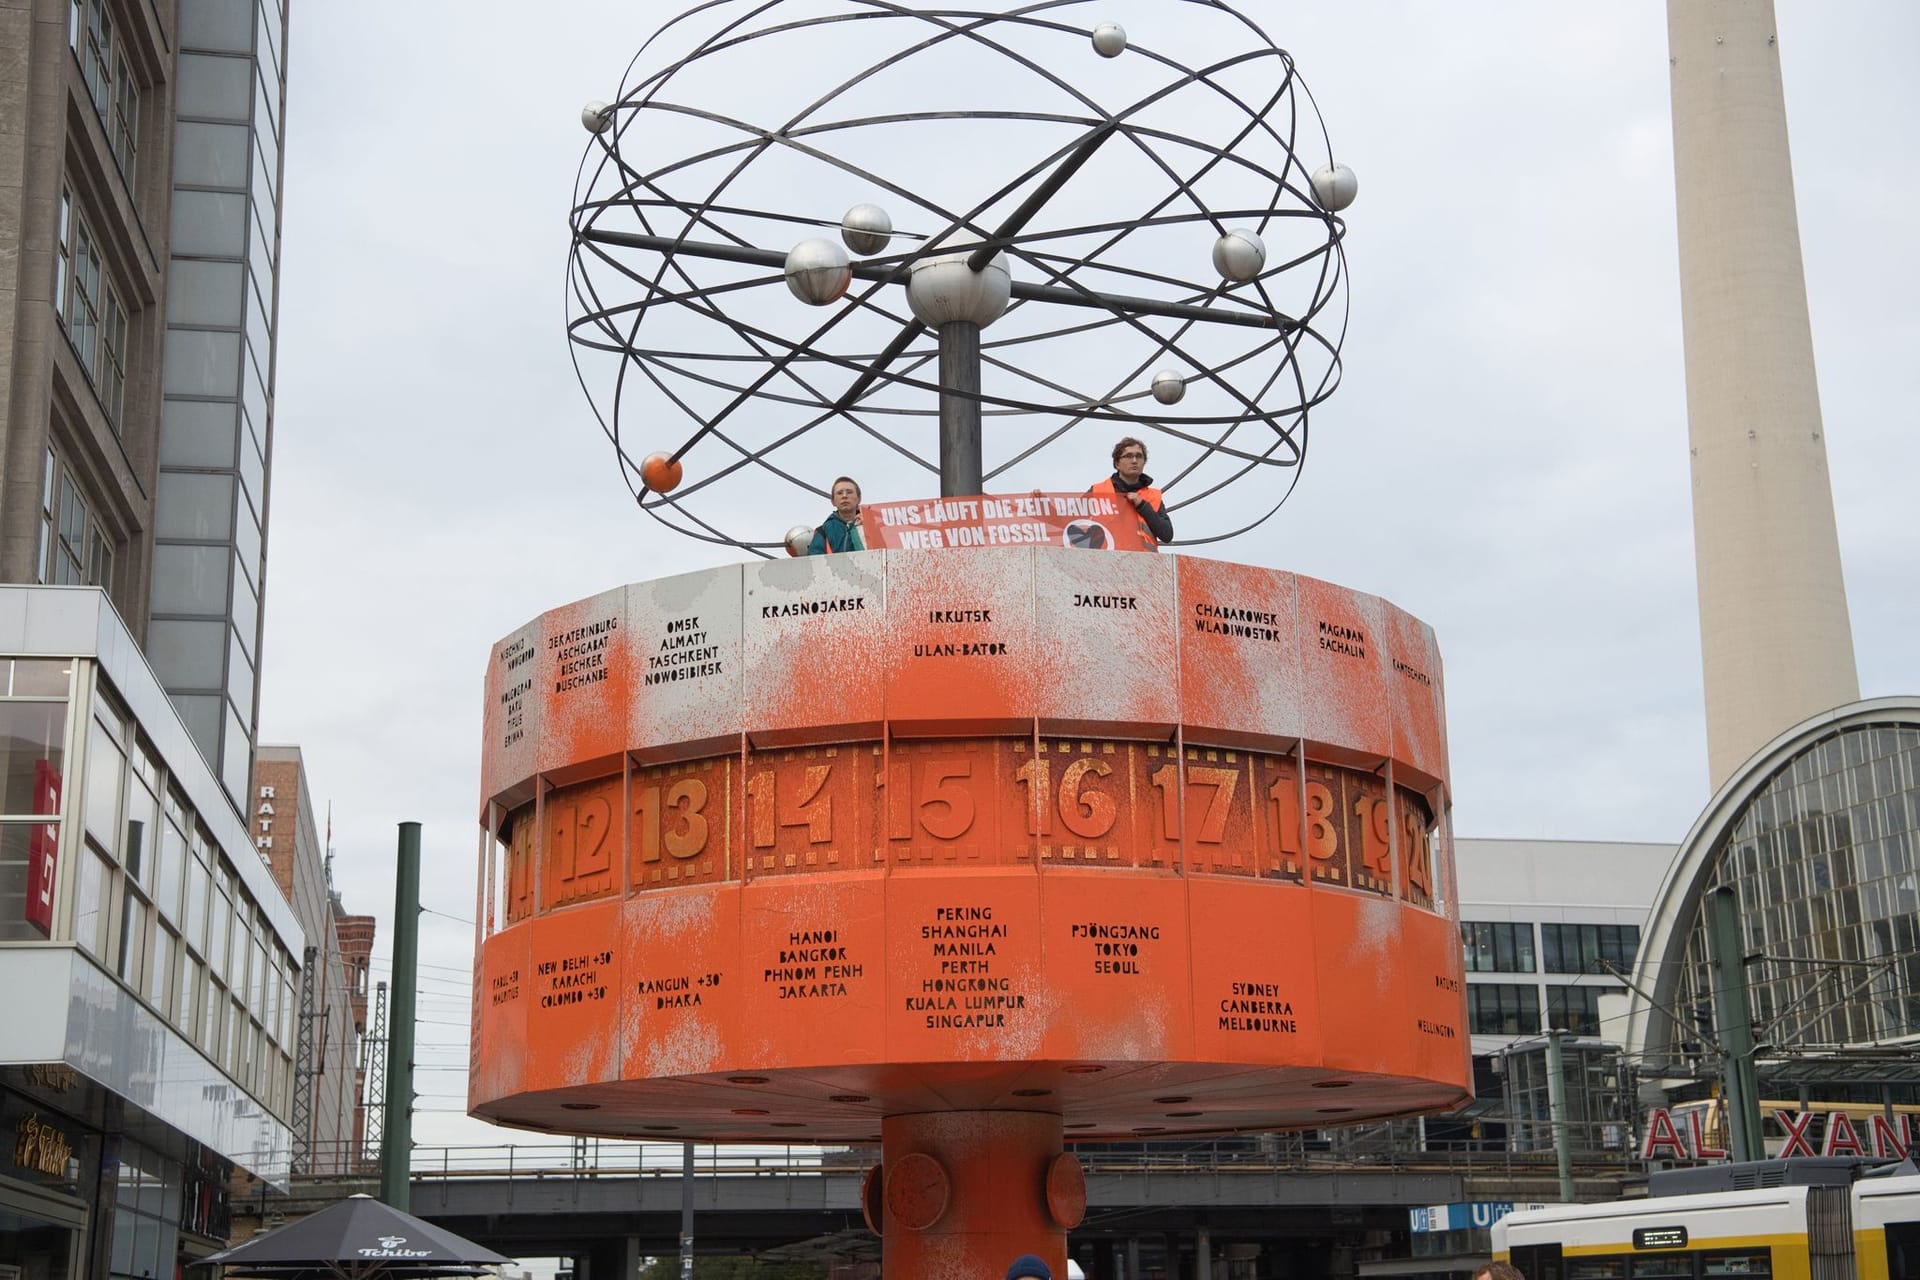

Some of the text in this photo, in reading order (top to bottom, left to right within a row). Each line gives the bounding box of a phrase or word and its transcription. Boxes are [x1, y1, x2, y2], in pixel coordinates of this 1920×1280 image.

[880, 496, 1119, 526] UNS LÄUFT DIE ZEIT DAVON:
[899, 522, 1051, 550] WEG VON FOSSIL
[762, 598, 865, 618] KRASNOJARSK
[1074, 594, 1138, 610] JAKUTSK
[930, 610, 991, 623] IRKUTSK
[1196, 603, 1278, 627] CHABAROWSK
[549, 617, 617, 649] JEKATERINBURG
[667, 617, 699, 634] OMSK
[1196, 620, 1280, 643] WLADIWOSTOK
[1319, 621, 1364, 643] MAGADAN
[556, 635, 609, 662] ASCHGABAT
[660, 632, 707, 651] ALMATY
[914, 643, 1007, 657] ULAN-BATOR
[1319, 640, 1365, 659] SACHALIN
[561, 654, 603, 676] BISCHKEK
[649, 646, 719, 669] TASCHKENT
[556, 668, 608, 693] DUSCHANBE
[645, 661, 722, 686] NOWOSIBIRSK
[747, 765, 832, 848] 14
[876, 759, 975, 840] 15
[1016, 757, 1117, 838] 16
[1152, 764, 1240, 843] 17
[635, 778, 708, 863] 13
[1269, 777, 1338, 859] 18
[558, 794, 612, 882] 12
[937, 907, 992, 921] PEKING
[790, 930, 837, 946] HANOI
[922, 924, 1007, 939] SHANGHAI
[1072, 922, 1160, 940] PJÖNGJANG
[780, 948, 847, 964] BANGKOK
[934, 942, 996, 956] MANILA
[1095, 943, 1138, 957] TOKYO
[538, 962, 557, 976] NEW
[562, 956, 589, 971] DELHI
[764, 964, 863, 982] PHNOM PENH
[942, 961, 989, 974] PERTH
[1095, 961, 1139, 974] SEOUL
[552, 971, 597, 990] KARACHI
[638, 977, 689, 994] RANGUN
[923, 978, 1009, 992] HONGKONG
[1232, 982, 1279, 998] SYDNEY
[541, 991, 583, 1009] COLOMBO
[779, 983, 847, 999] JAKARTA
[657, 994, 702, 1010] DHAKA
[906, 995, 1025, 1011] KUALA LUMPUR
[1221, 1000, 1293, 1015] CANBERRA
[926, 1014, 1005, 1028] SINGAPUR
[1218, 1016, 1297, 1033] MELBOURNE
[1418, 1019, 1455, 1038] WELLINGTON
[1641, 1108, 1912, 1159] ALXAN
[1473, 1203, 1490, 1226] U
[357, 1248, 432, 1257] Tchibo
